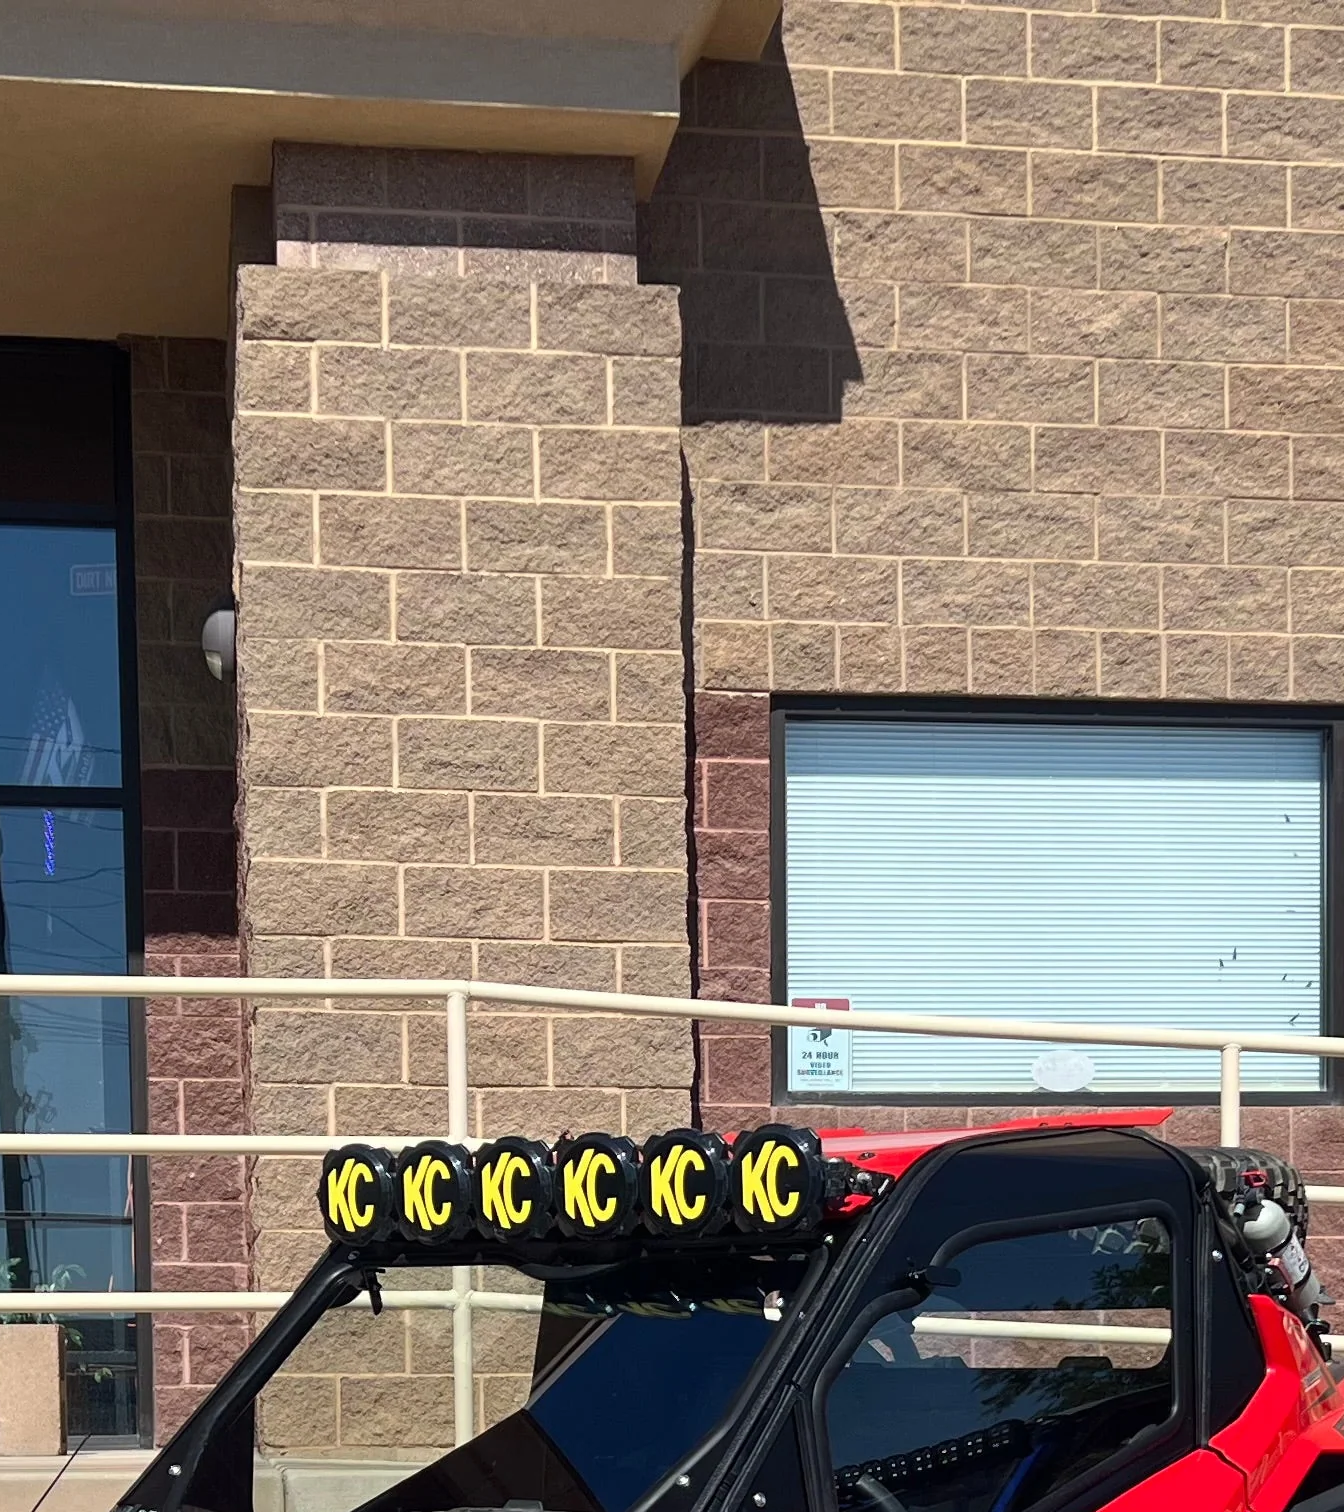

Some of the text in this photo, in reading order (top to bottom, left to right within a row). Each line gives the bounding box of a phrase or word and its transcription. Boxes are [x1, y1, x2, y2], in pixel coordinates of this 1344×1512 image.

[801, 1051, 813, 1060] 24
[327, 1158, 374, 1232] KC
[403, 1154, 452, 1231] KC
[481, 1151, 532, 1229] KC
[564, 1148, 617, 1227] KC
[651, 1144, 705, 1225] KC
[742, 1140, 800, 1223] KC
